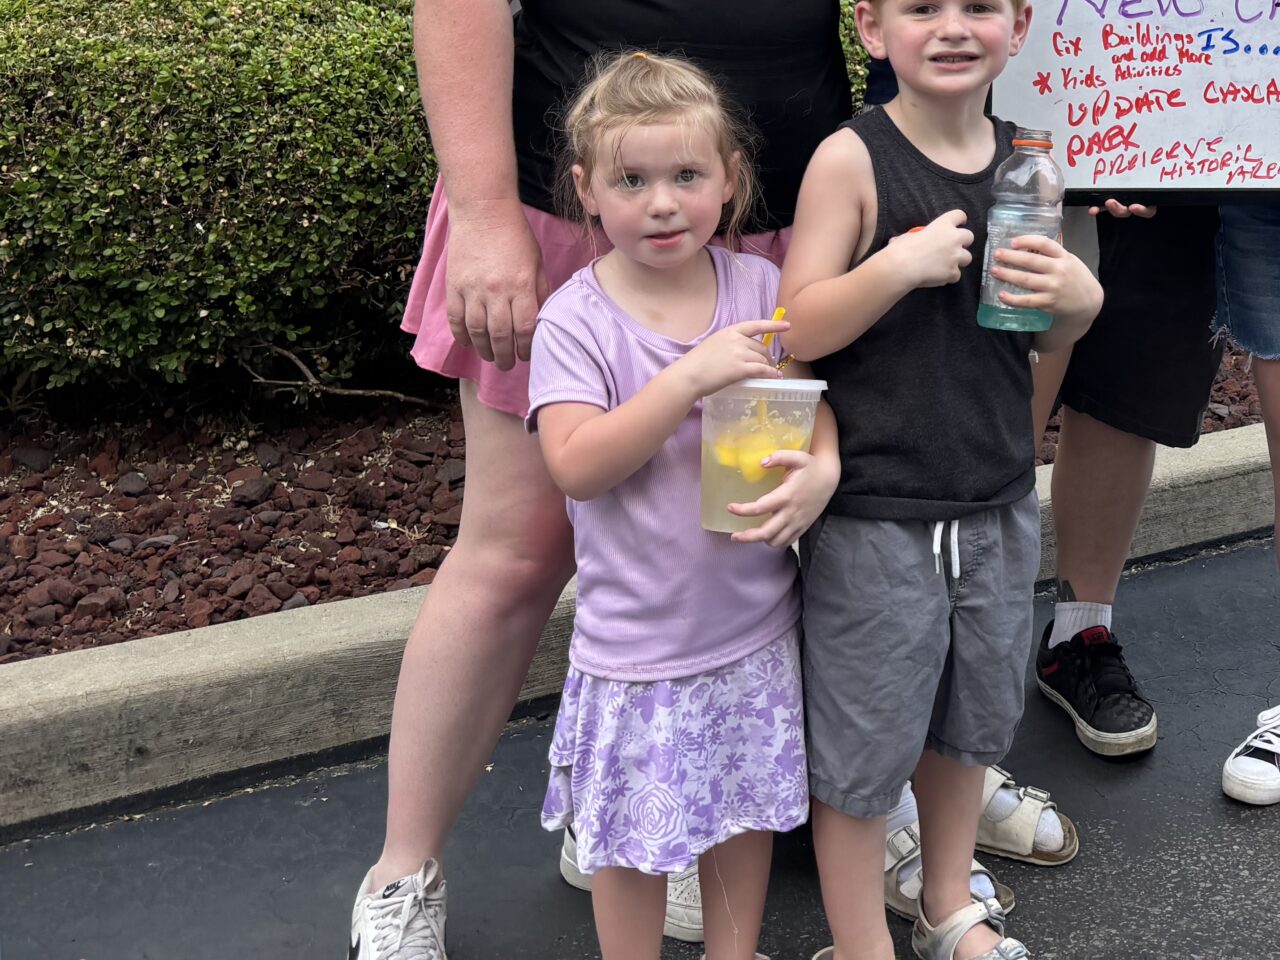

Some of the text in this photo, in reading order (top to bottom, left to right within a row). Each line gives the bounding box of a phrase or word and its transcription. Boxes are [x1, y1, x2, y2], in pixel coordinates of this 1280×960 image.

[1102, 22, 1195, 52] Buildings
[1140, 43, 1170, 63] add
[1060, 65, 1108, 90] Kids
